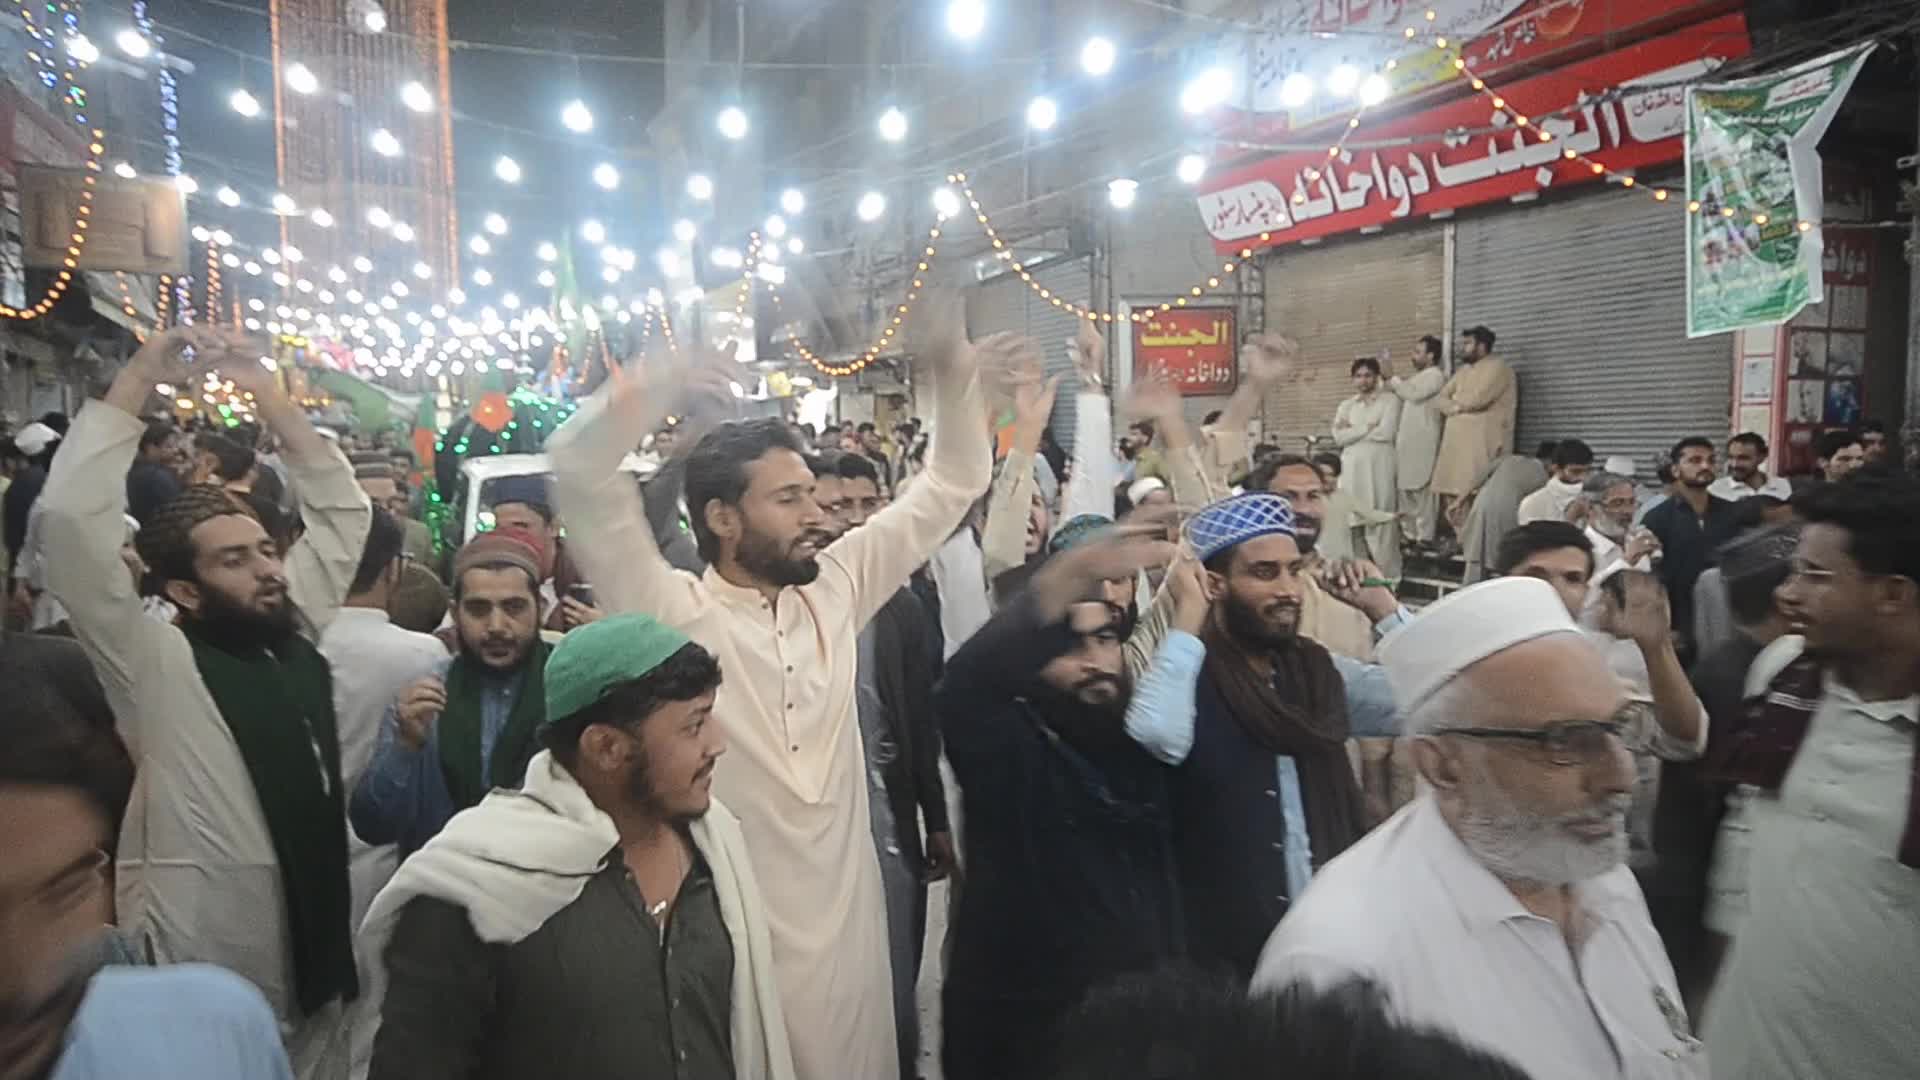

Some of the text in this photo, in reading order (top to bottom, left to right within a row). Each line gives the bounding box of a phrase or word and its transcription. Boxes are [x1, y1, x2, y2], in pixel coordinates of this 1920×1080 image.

[1290, 90, 1620, 223] الجنت دواخانہ
[1141, 320, 1228, 358] الجنت
